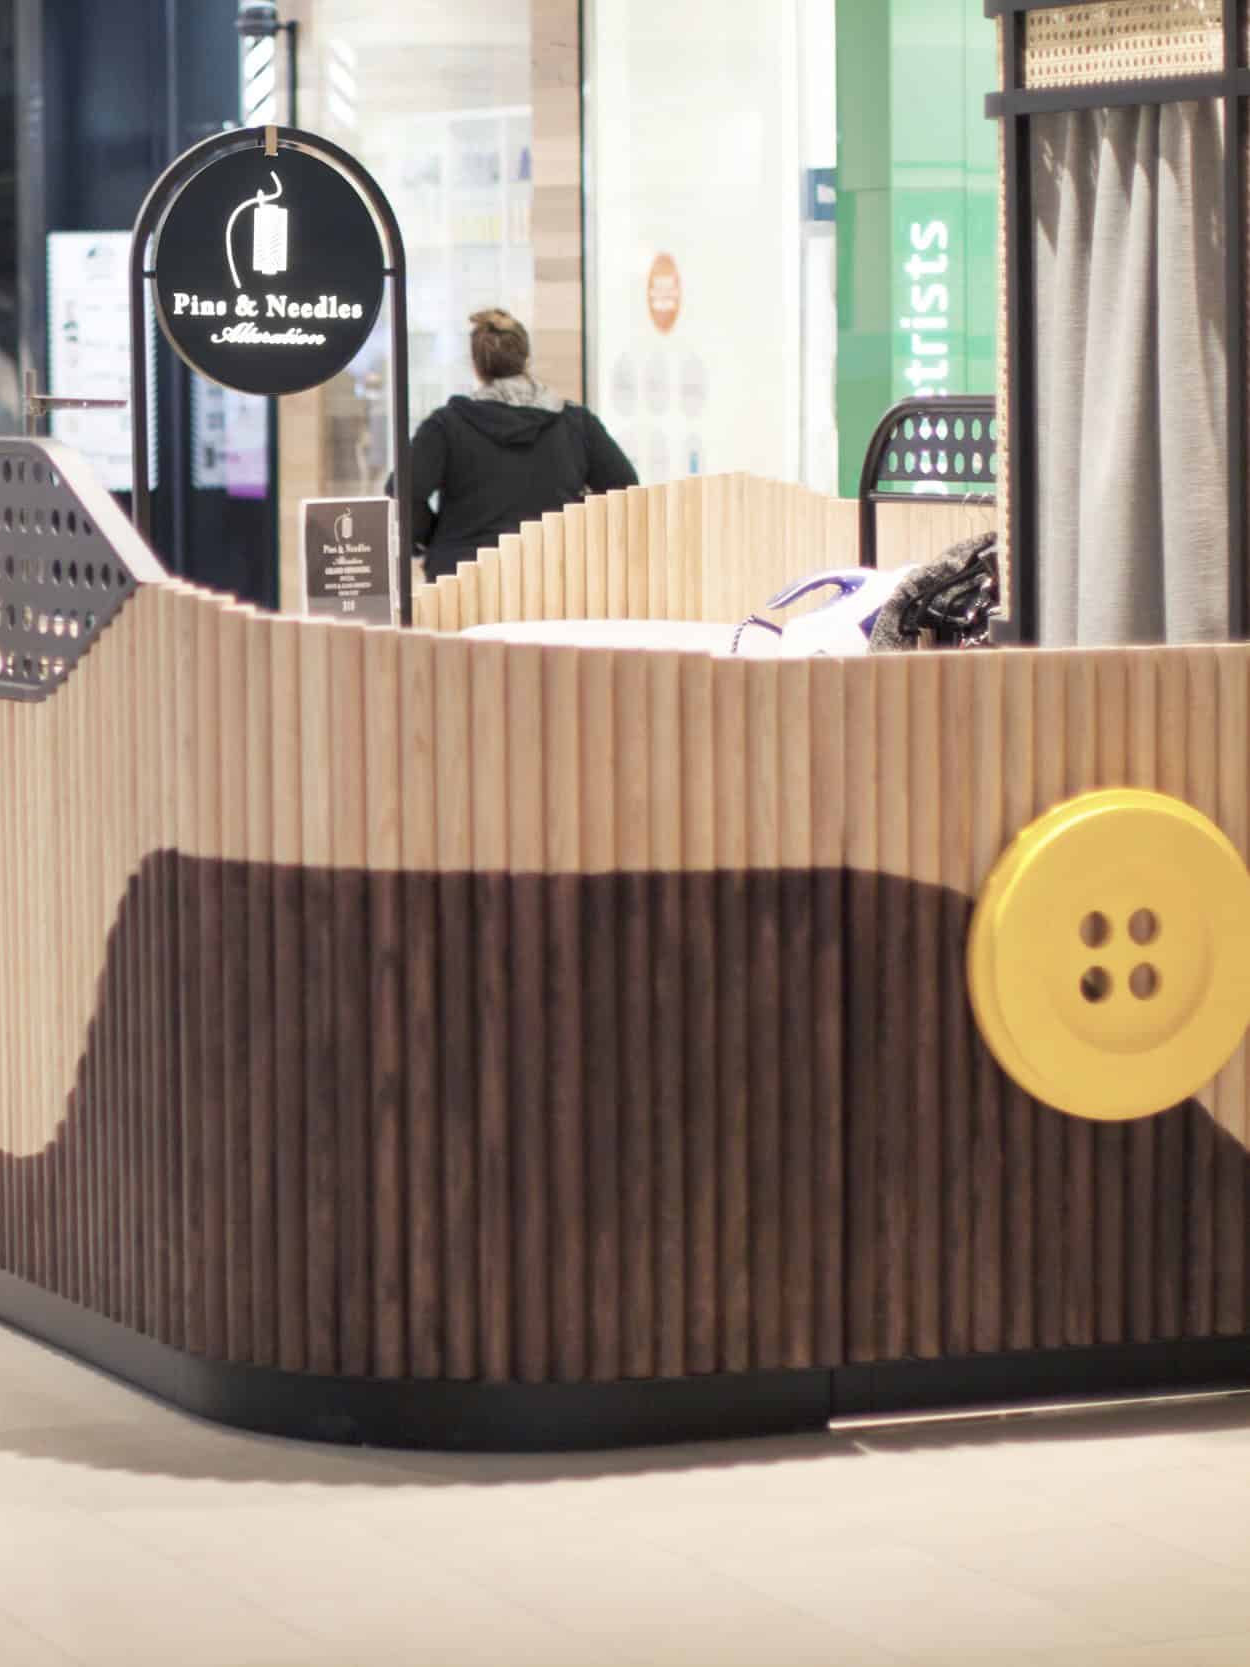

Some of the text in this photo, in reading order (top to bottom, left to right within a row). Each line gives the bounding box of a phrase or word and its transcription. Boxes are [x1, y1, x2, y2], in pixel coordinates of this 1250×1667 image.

[173, 292, 363, 319] Pins & Needles
[210, 321, 326, 345] Alteration
